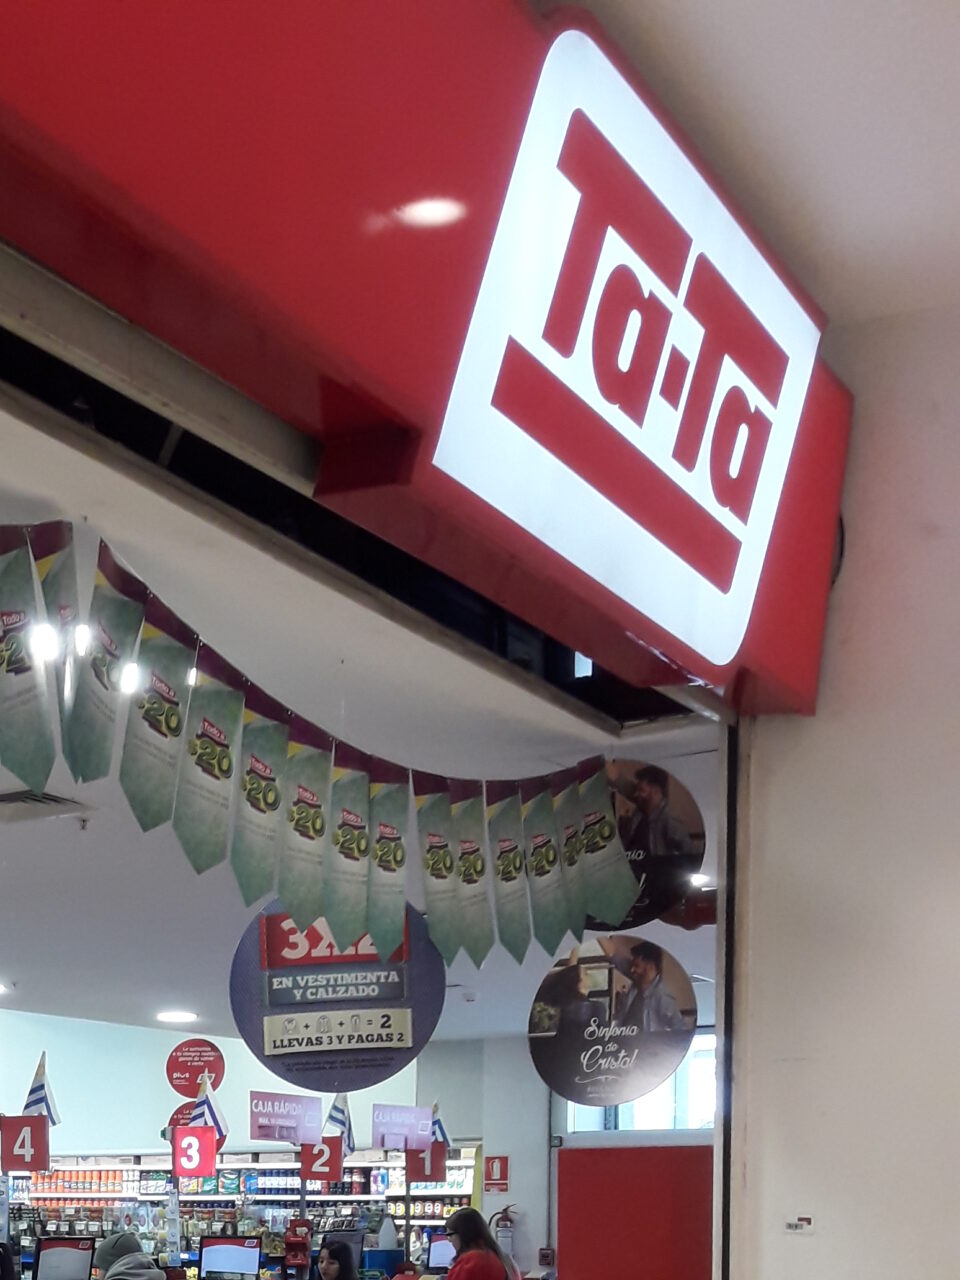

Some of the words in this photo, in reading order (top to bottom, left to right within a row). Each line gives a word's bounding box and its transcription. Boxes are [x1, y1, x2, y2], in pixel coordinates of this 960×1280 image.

[188, 737, 233, 779] $20
[272, 975, 293, 990] EN
[296, 970, 400, 986] VESTIMENTA
[293, 989, 303, 1001] Y
[306, 984, 380, 1000] CALZADO
[380, 1013, 392, 1030] 2
[272, 1035, 323, 1050] LLEVAS
[326, 1035, 334, 1046] 3
[334, 1035, 344, 1046] Y
[347, 1033, 394, 1045] PAGAS
[397, 1032, 405, 1043] 2
[605, 1042, 618, 1052] de
[581, 1045, 639, 1072] Cristal
[252, 1100, 273, 1113] CAJA
[13, 1126, 35, 1162] 4
[180, 1136, 200, 1169] 3
[312, 1144, 330, 1173] 2
[418, 1147, 432, 1176] 1
